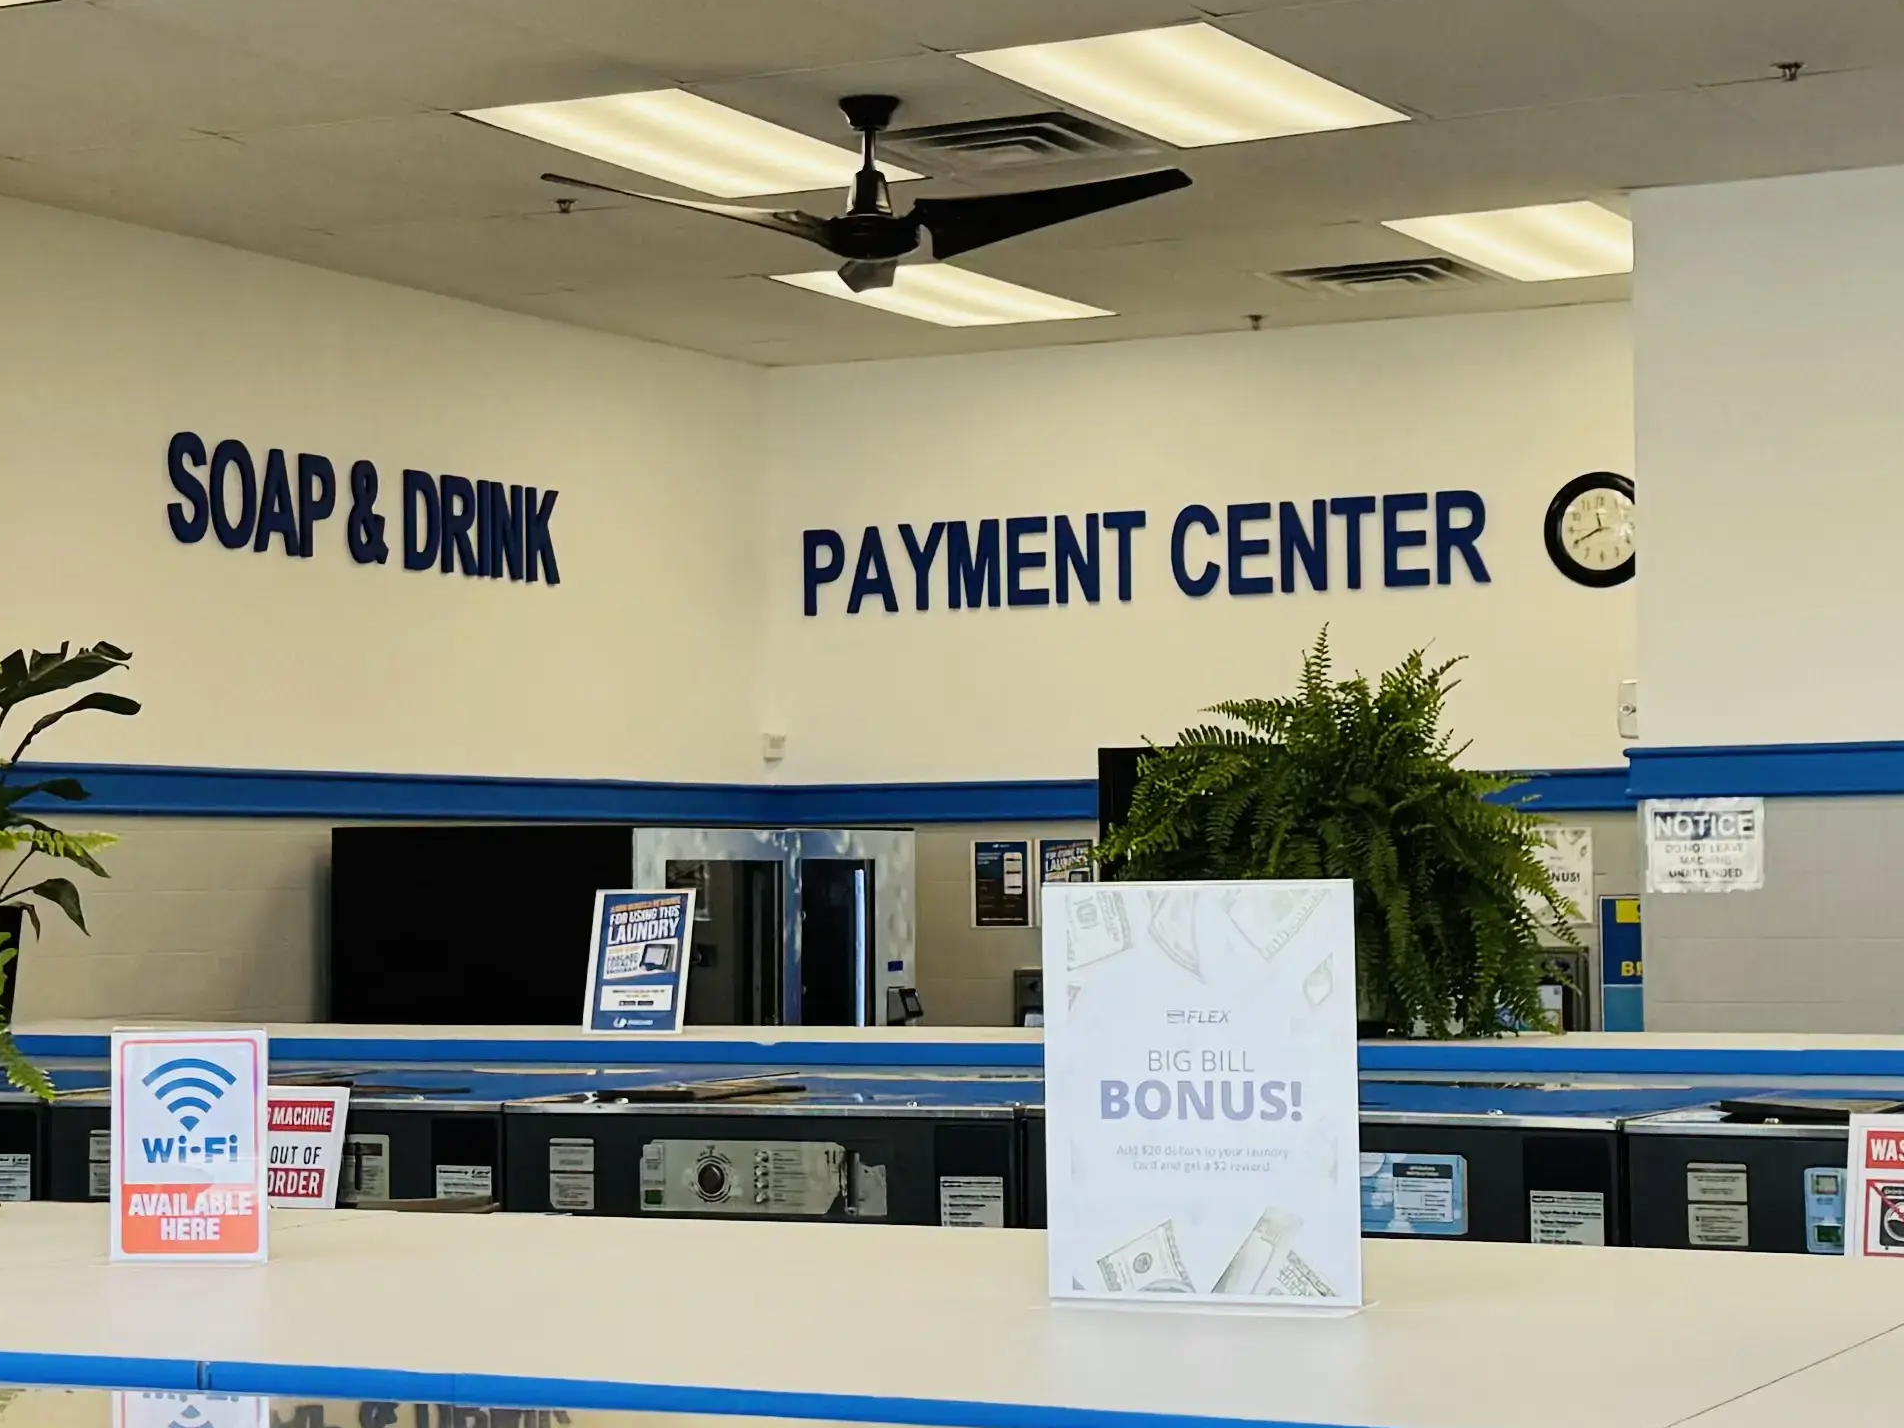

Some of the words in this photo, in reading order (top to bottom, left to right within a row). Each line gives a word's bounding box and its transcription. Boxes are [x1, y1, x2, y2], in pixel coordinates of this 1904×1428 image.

[167, 431, 336, 558] SOAP
[347, 460, 389, 565] &
[402, 469, 561, 586] DRINK
[802, 509, 1146, 616] PAYMENT
[1170, 489, 1492, 598] CENTER
[1655, 814, 1755, 837] NOTICE
[1684, 843, 1707, 854] NOT
[1668, 868, 1743, 878] UNATTENDED
[610, 911, 629, 926] FOR
[659, 904, 681, 919] THIS
[607, 917, 680, 946] LAUNDRY
[1186, 1009, 1232, 1024] FLEX
[1148, 1049, 1192, 1072] BIG
[1201, 1049, 1255, 1073] BILL
[1100, 1079, 1303, 1122] BONUS!
[272, 1106, 333, 1126] MACHINE
[270, 1145, 299, 1166] OUT
[303, 1145, 322, 1166] OF
[267, 1171, 321, 1195] ORDER
[128, 1192, 256, 1218] AVAILABLE
[160, 1218, 221, 1241] HERE
